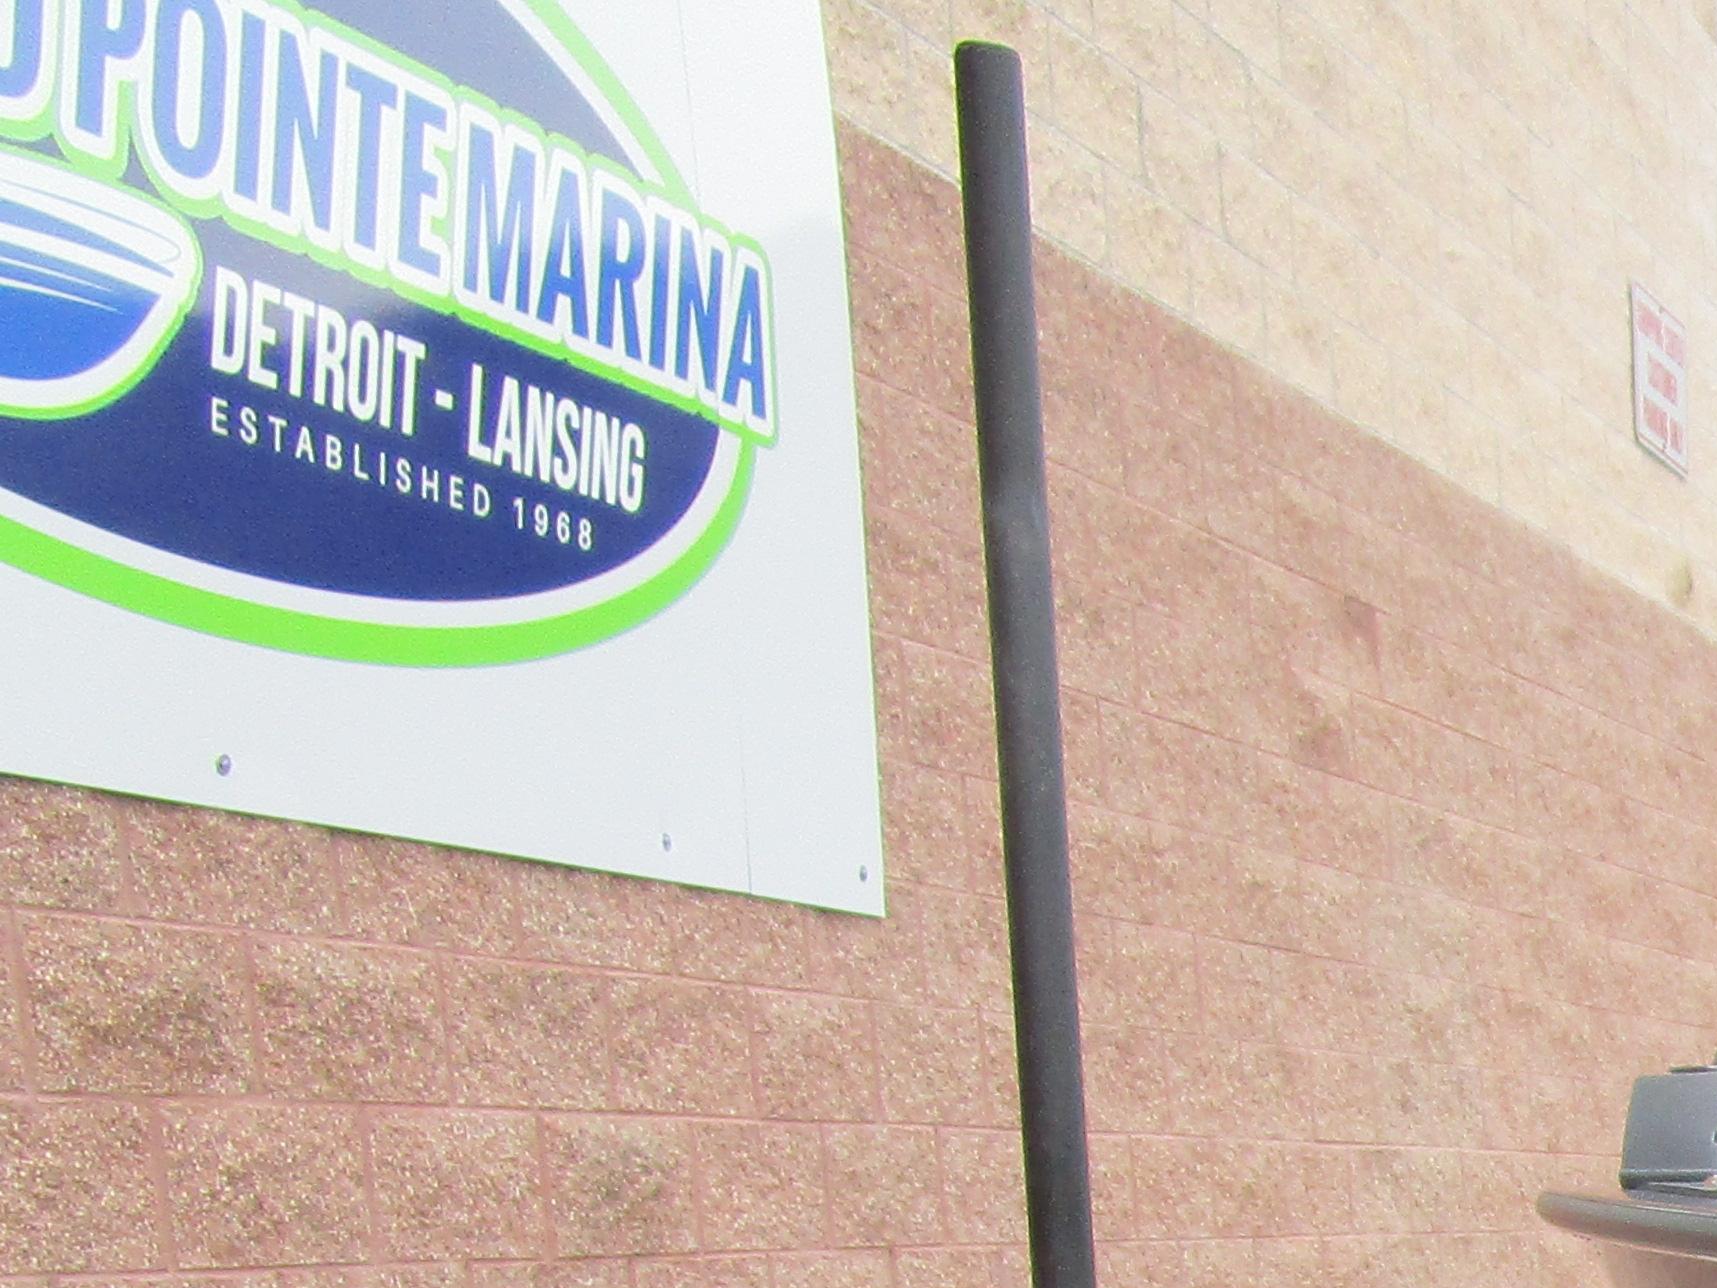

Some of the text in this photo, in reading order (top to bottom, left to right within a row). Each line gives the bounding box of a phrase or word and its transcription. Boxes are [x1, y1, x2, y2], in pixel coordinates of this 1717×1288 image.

[210, 265, 427, 436] DETROIT
[467, 362, 646, 514] LANSING
[210, 396, 594, 552] ESTABLISHED 1968
